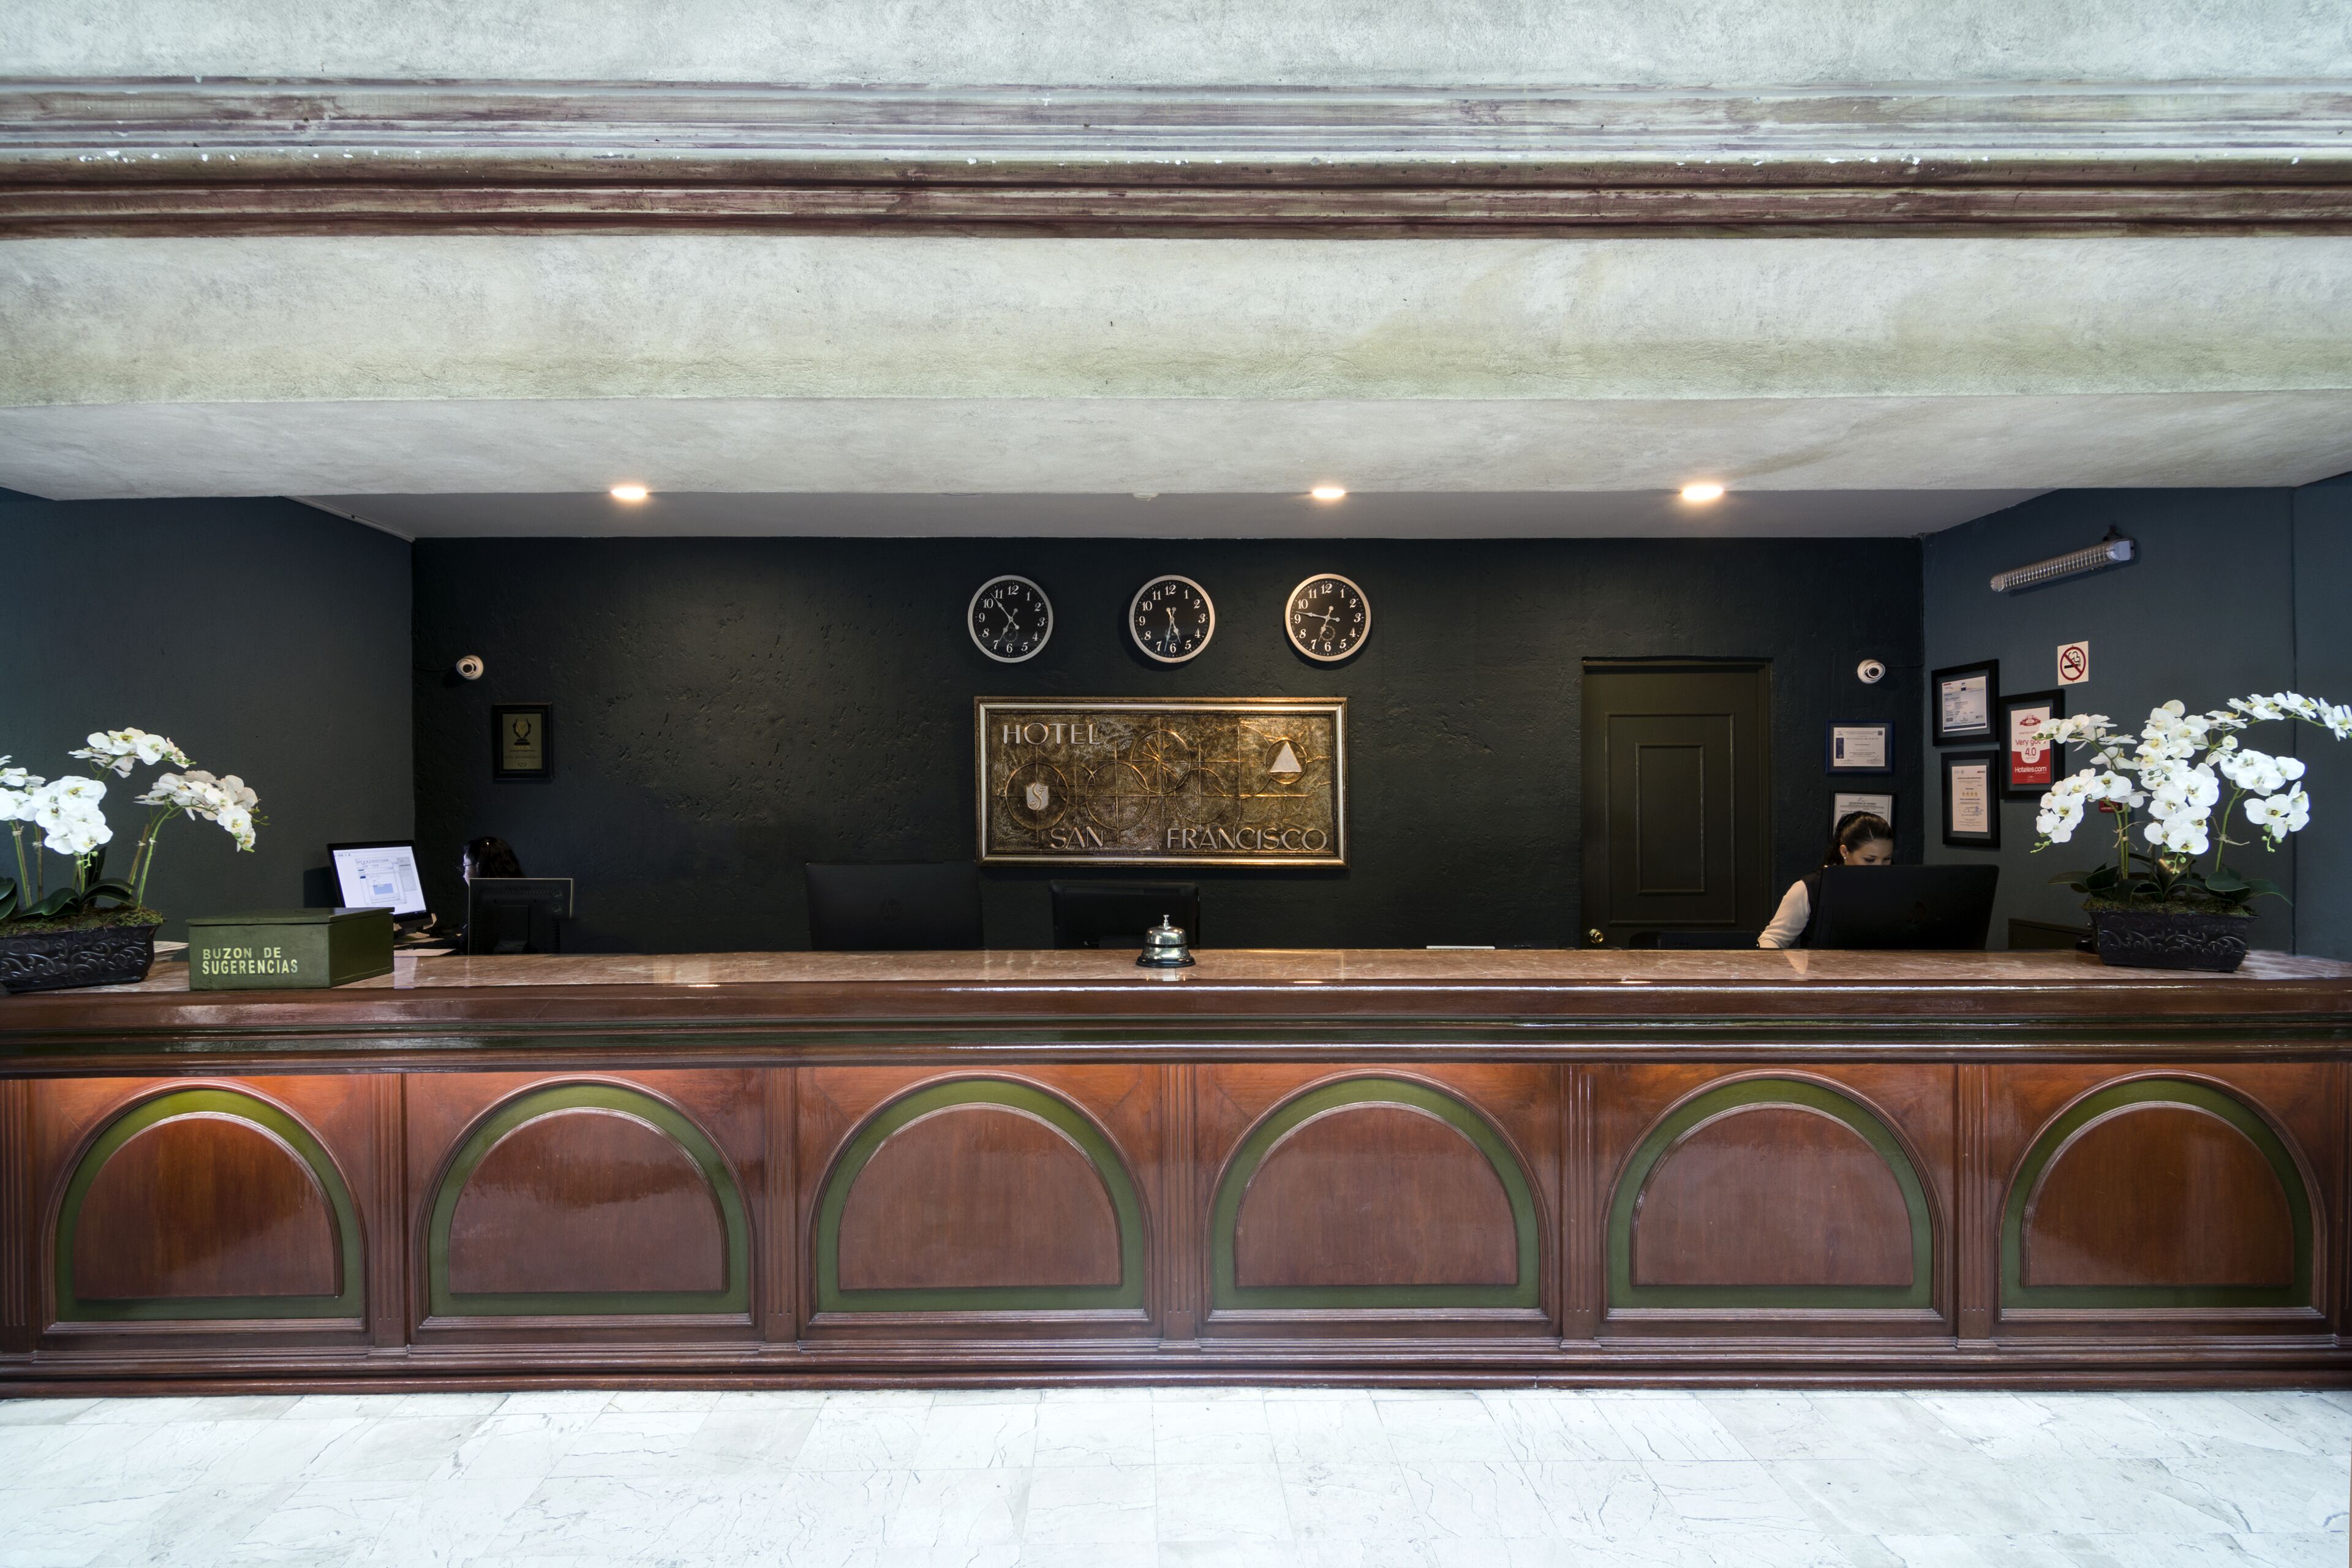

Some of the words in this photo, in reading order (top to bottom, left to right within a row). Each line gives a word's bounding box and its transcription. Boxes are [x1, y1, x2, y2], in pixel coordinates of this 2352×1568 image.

[995, 589, 1003, 598] 11
[1008, 586, 1019, 595] 12
[1165, 585, 1176, 595] 12
[1185, 589, 1188, 598] 1
[1308, 589, 1317, 598] 11
[1321, 584, 1332, 594] 12
[1340, 589, 1344, 598] 1
[1027, 592, 1030, 601] 1
[1153, 590, 1161, 600] 11
[983, 598, 993, 608] 10
[1035, 603, 1041, 612] 2
[1142, 601, 1152, 611] 10
[1194, 600, 1200, 609] 2
[1298, 599, 1308, 609] 10
[1349, 598, 1355, 608] 2
[979, 612, 985, 622] 9
[1038, 617, 1045, 627] 3
[1139, 616, 1145, 625] 9
[1199, 614, 1205, 623] 3
[1295, 614, 1300, 624] 9
[1354, 613, 1361, 622] 3
[982, 628, 989, 637] 8
[1033, 631, 1038, 641] 4
[1145, 631, 1151, 640] 8
[1195, 628, 1200, 638] 4
[1300, 629, 1306, 638] 8
[1350, 628, 1355, 637] 4
[993, 640, 999, 649] 7
[1006, 643, 1012, 653] 6
[1022, 642, 1028, 651] 5
[1156, 641, 1161, 651] 7
[1170, 643, 1176, 652] 6
[1185, 640, 1191, 649] 5
[1311, 639, 1317, 649] 7
[1325, 642, 1331, 652] 6
[1340, 639, 1346, 649] 5
[1003, 723, 1101, 745] HOTEL
[2025, 747, 2037, 756] 4.0
[1049, 826, 1102, 849] SAN
[1166, 827, 1328, 850] FRANCISCO
[203, 948, 252, 960] BUZON
[264, 947, 281, 958] DE
[202, 959, 298, 974] SUGERENCIAS
